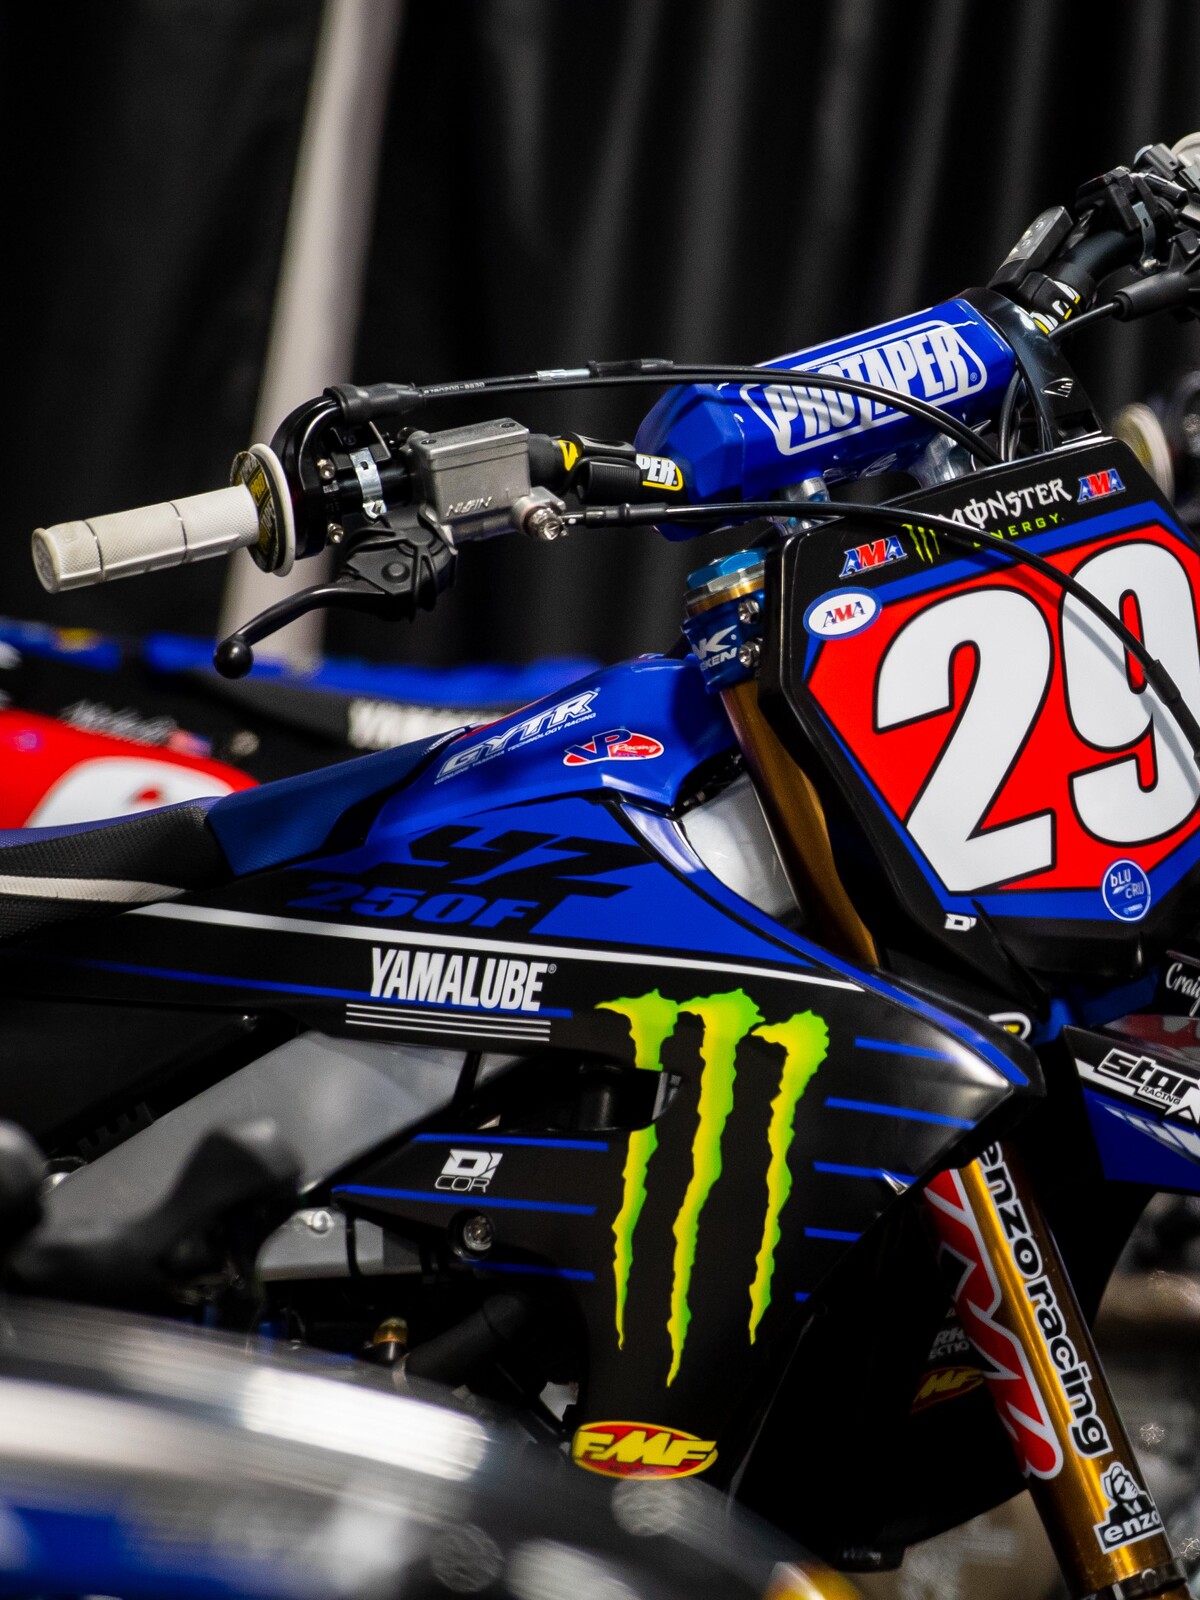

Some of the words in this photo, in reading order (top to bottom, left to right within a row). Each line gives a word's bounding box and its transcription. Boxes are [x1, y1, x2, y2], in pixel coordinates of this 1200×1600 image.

[763, 332, 970, 452] PROTAPER
[938, 478, 1073, 530] MONSTER
[1077, 468, 1127, 503] AMA
[838, 535, 908, 579] AMA
[822, 600, 868, 628] AMA
[436, 690, 599, 780] GYTR
[507, 726, 563, 752] TECHNOLOGY
[563, 711, 597, 730] RACING
[564, 728, 633, 761] VP
[287, 881, 541, 928] 250F
[369, 947, 550, 1013] YAMALUBE
[1141, 1084, 1181, 1106] RACING
[574, 1429, 718, 1468] FMF
